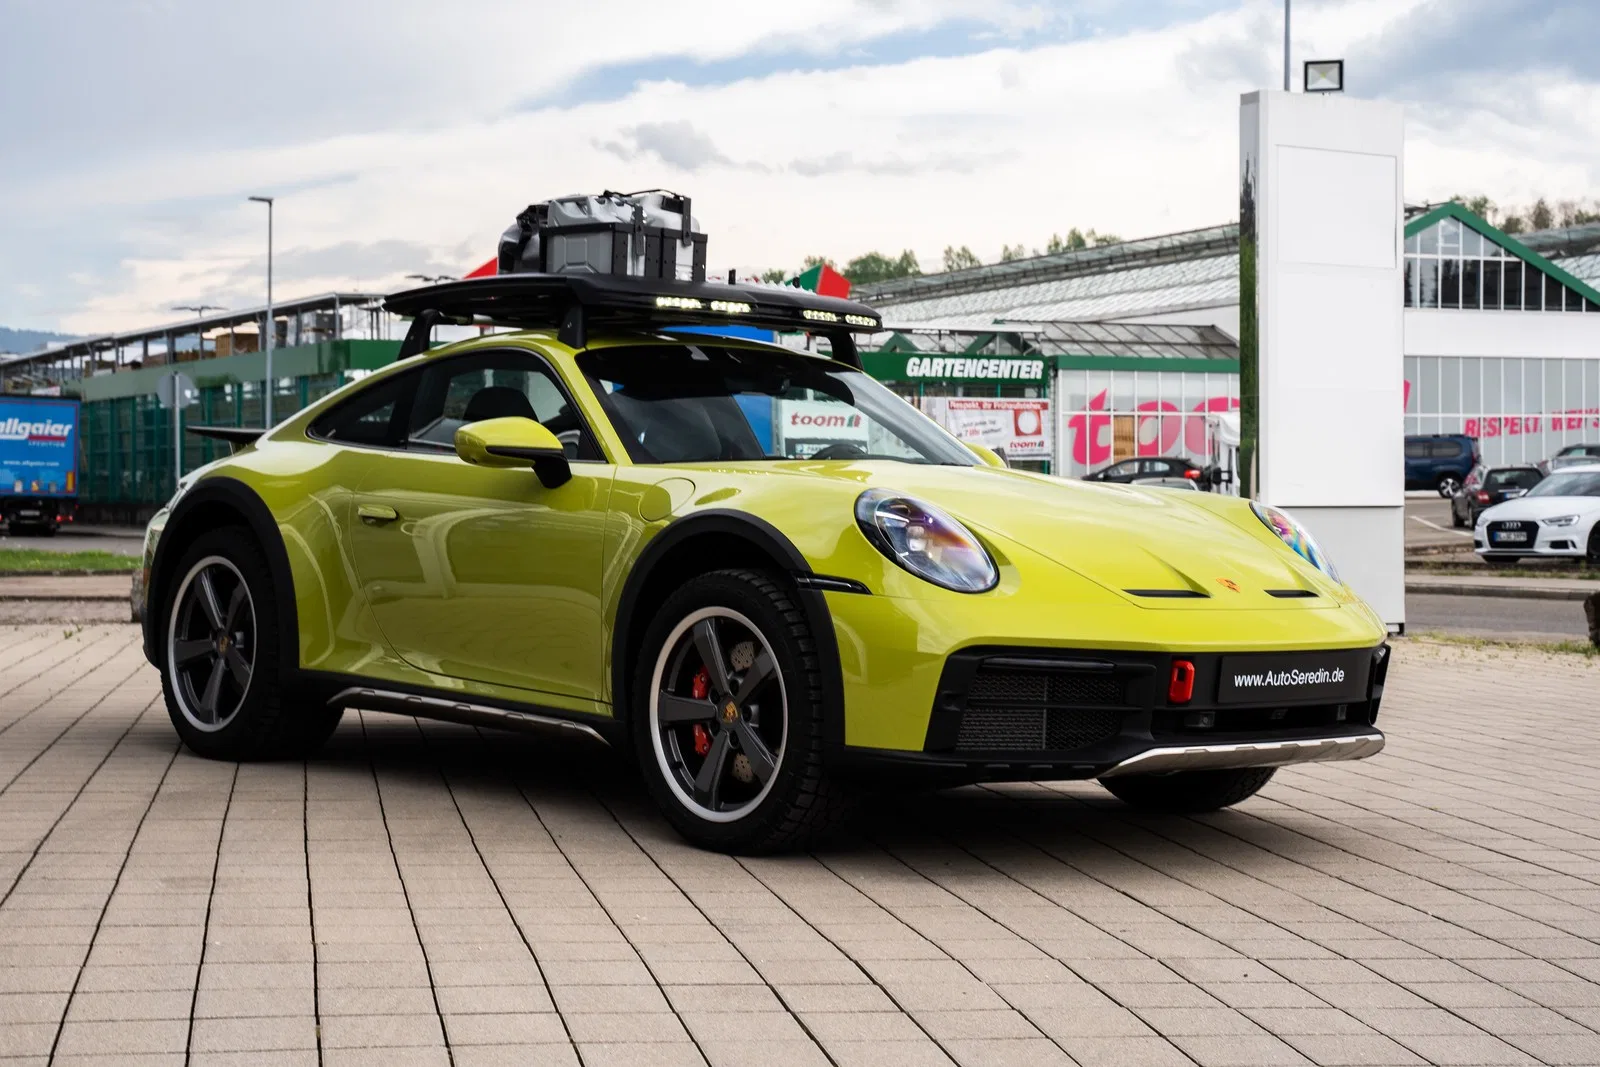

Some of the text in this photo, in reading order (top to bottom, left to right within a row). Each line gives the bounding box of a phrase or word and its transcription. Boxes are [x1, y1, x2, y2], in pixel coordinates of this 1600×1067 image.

[906, 357, 1044, 379] GARTENCENTER
[791, 411, 846, 427] toom
[1010, 440, 1037, 448] toom
[1234, 667, 1345, 687] www.AutoSeredin.de
